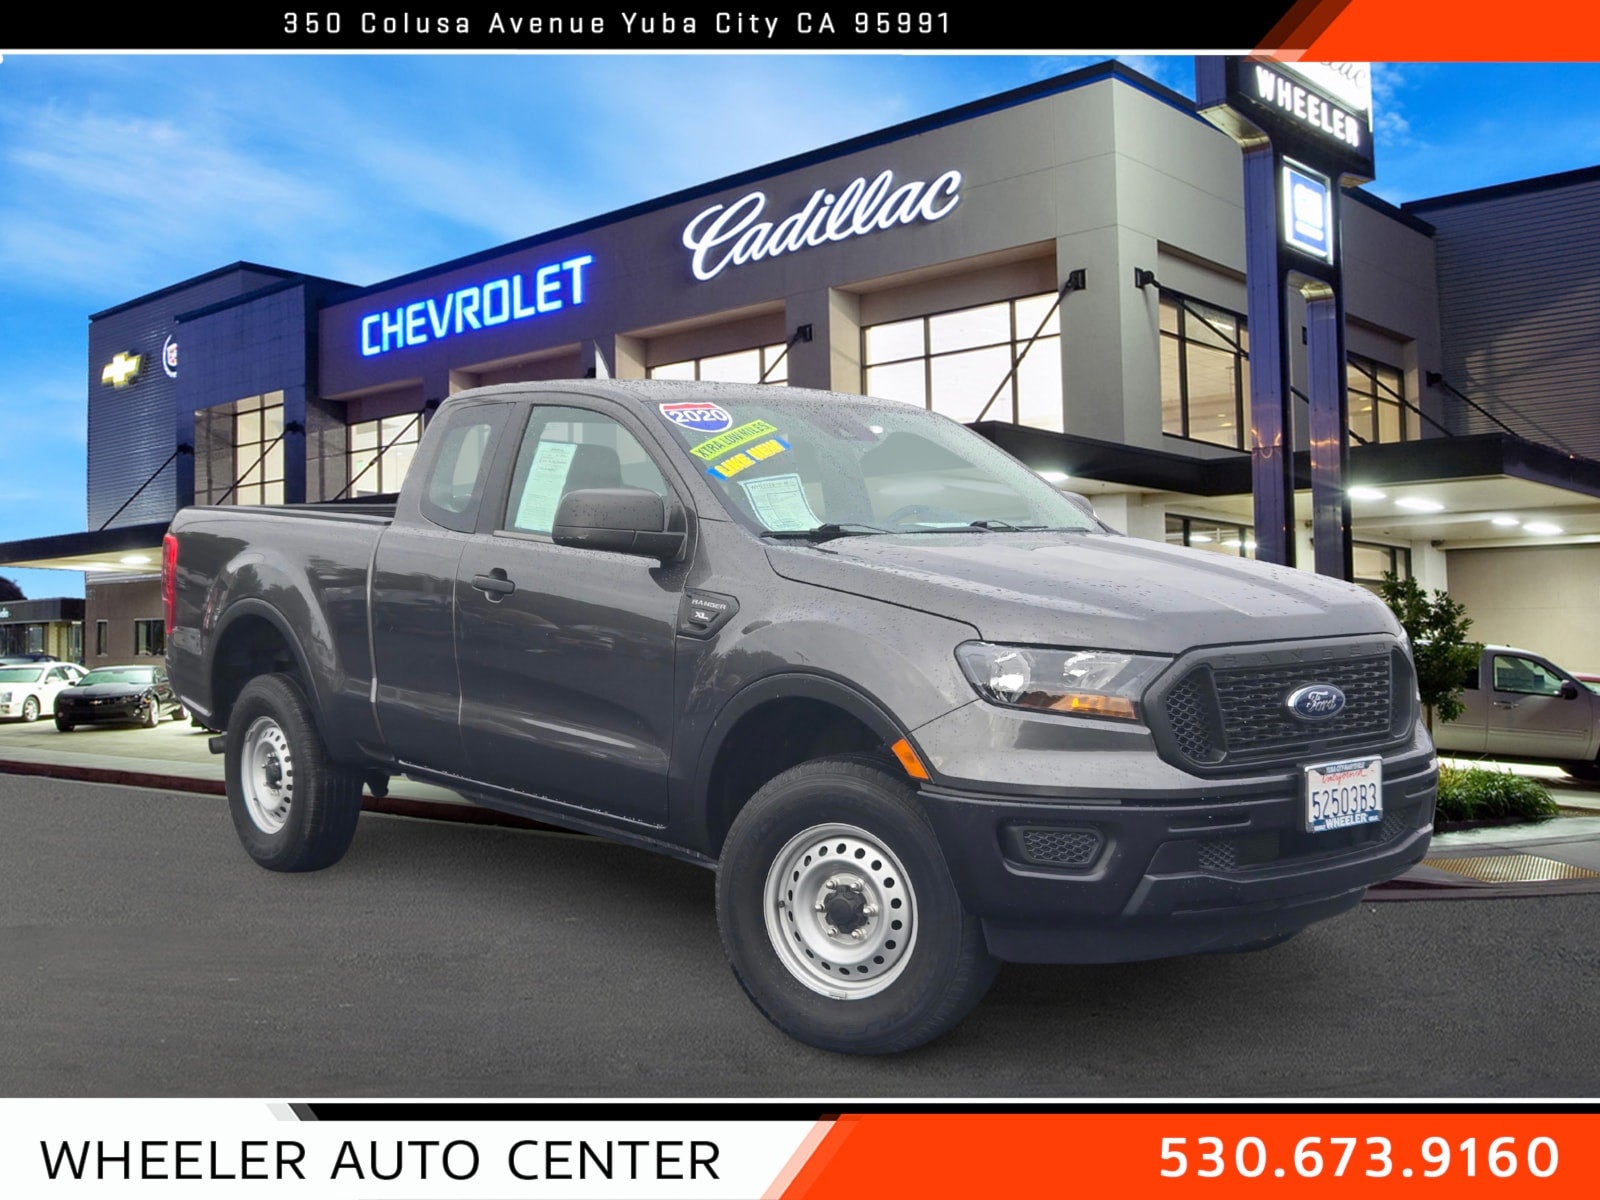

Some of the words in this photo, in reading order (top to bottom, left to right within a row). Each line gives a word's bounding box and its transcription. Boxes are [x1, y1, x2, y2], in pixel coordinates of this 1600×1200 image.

[1255, 65, 1360, 147] WHEELER
[683, 169, 963, 281] Cadillac
[361, 255, 594, 357] CHEVROLET
[669, 408, 728, 424] 2020
[696, 441, 724, 458] XTRA
[722, 431, 742, 445] LOW
[738, 421, 770, 439] MILES
[691, 598, 727, 611] RANGER
[694, 611, 709, 621] XL
[1306, 690, 1338, 714] Ford
[1322, 769, 1367, 785] California
[1312, 782, 1377, 820] 52503B3
[1325, 813, 1368, 830] WHEELER
